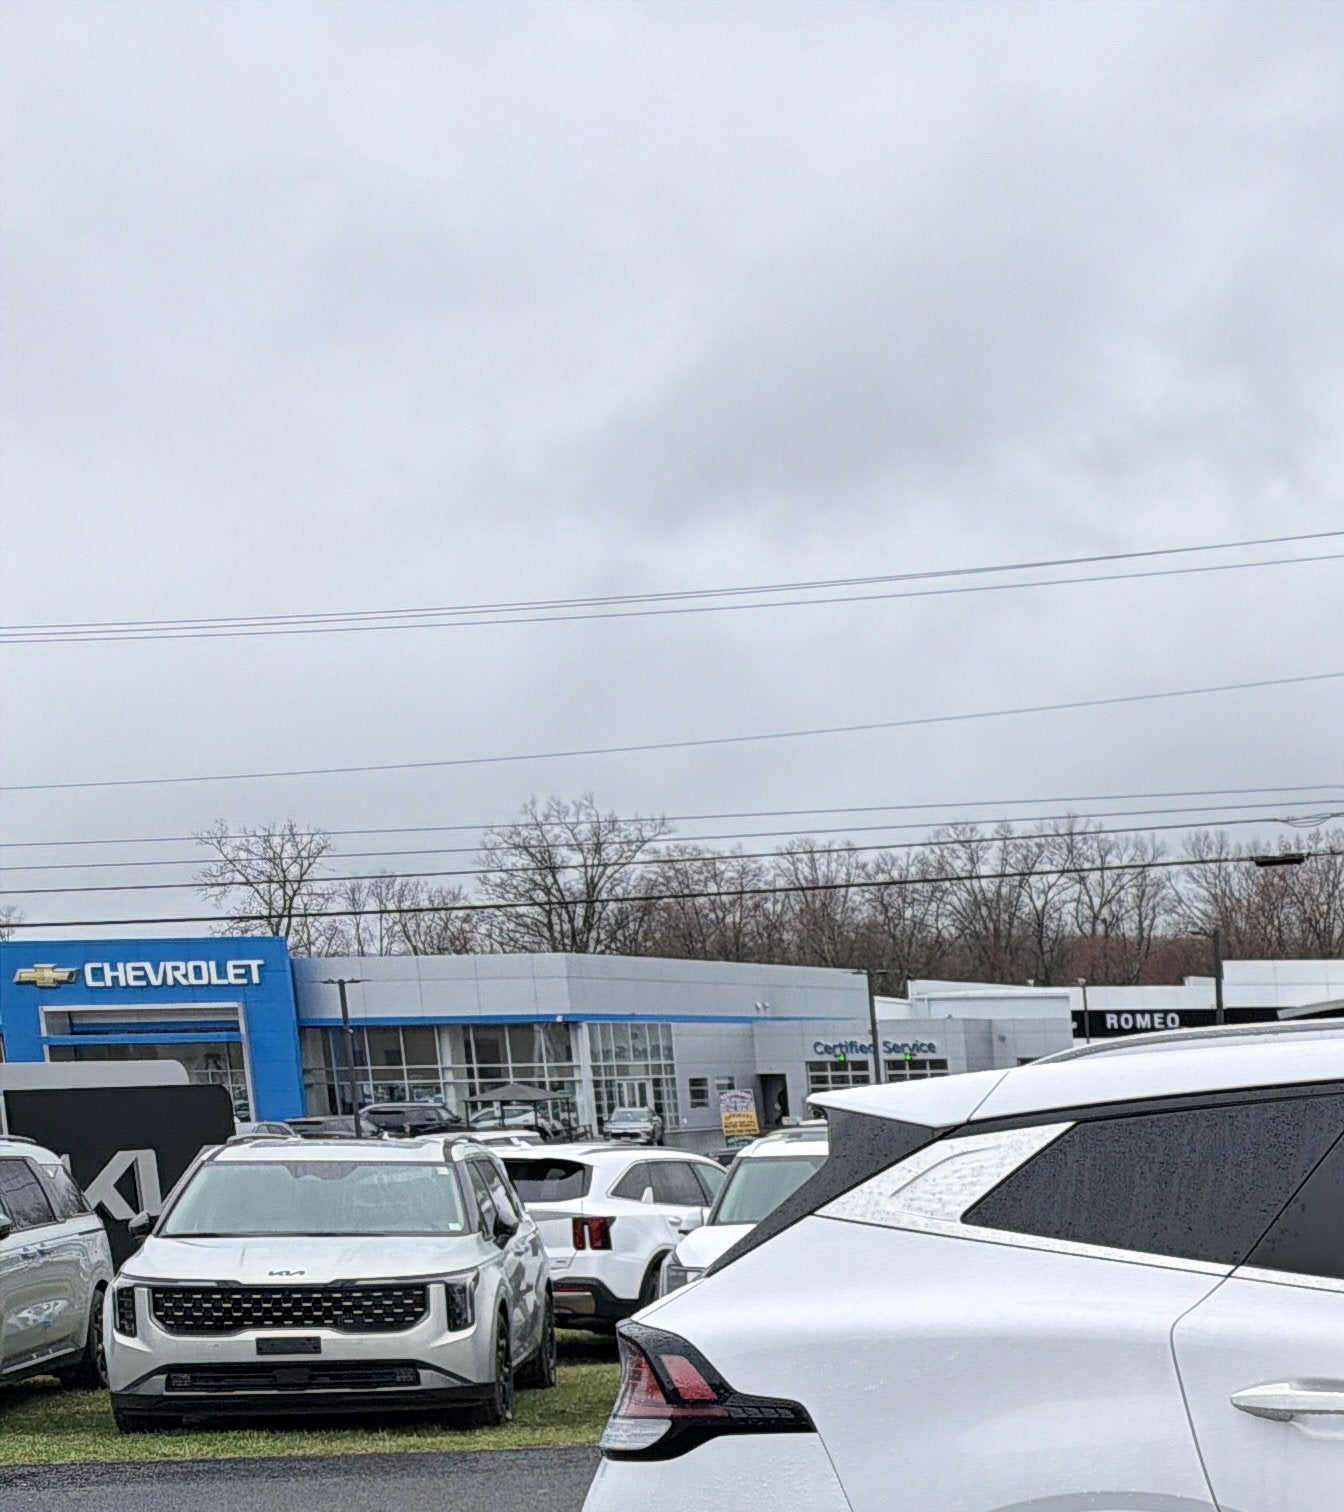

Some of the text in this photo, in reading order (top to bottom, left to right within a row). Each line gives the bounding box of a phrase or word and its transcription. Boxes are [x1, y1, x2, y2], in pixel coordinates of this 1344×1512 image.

[84, 959, 265, 987] CHEVROLET
[1105, 1013, 1180, 1029] ROMEO
[882, 1039, 937, 1055] Service
